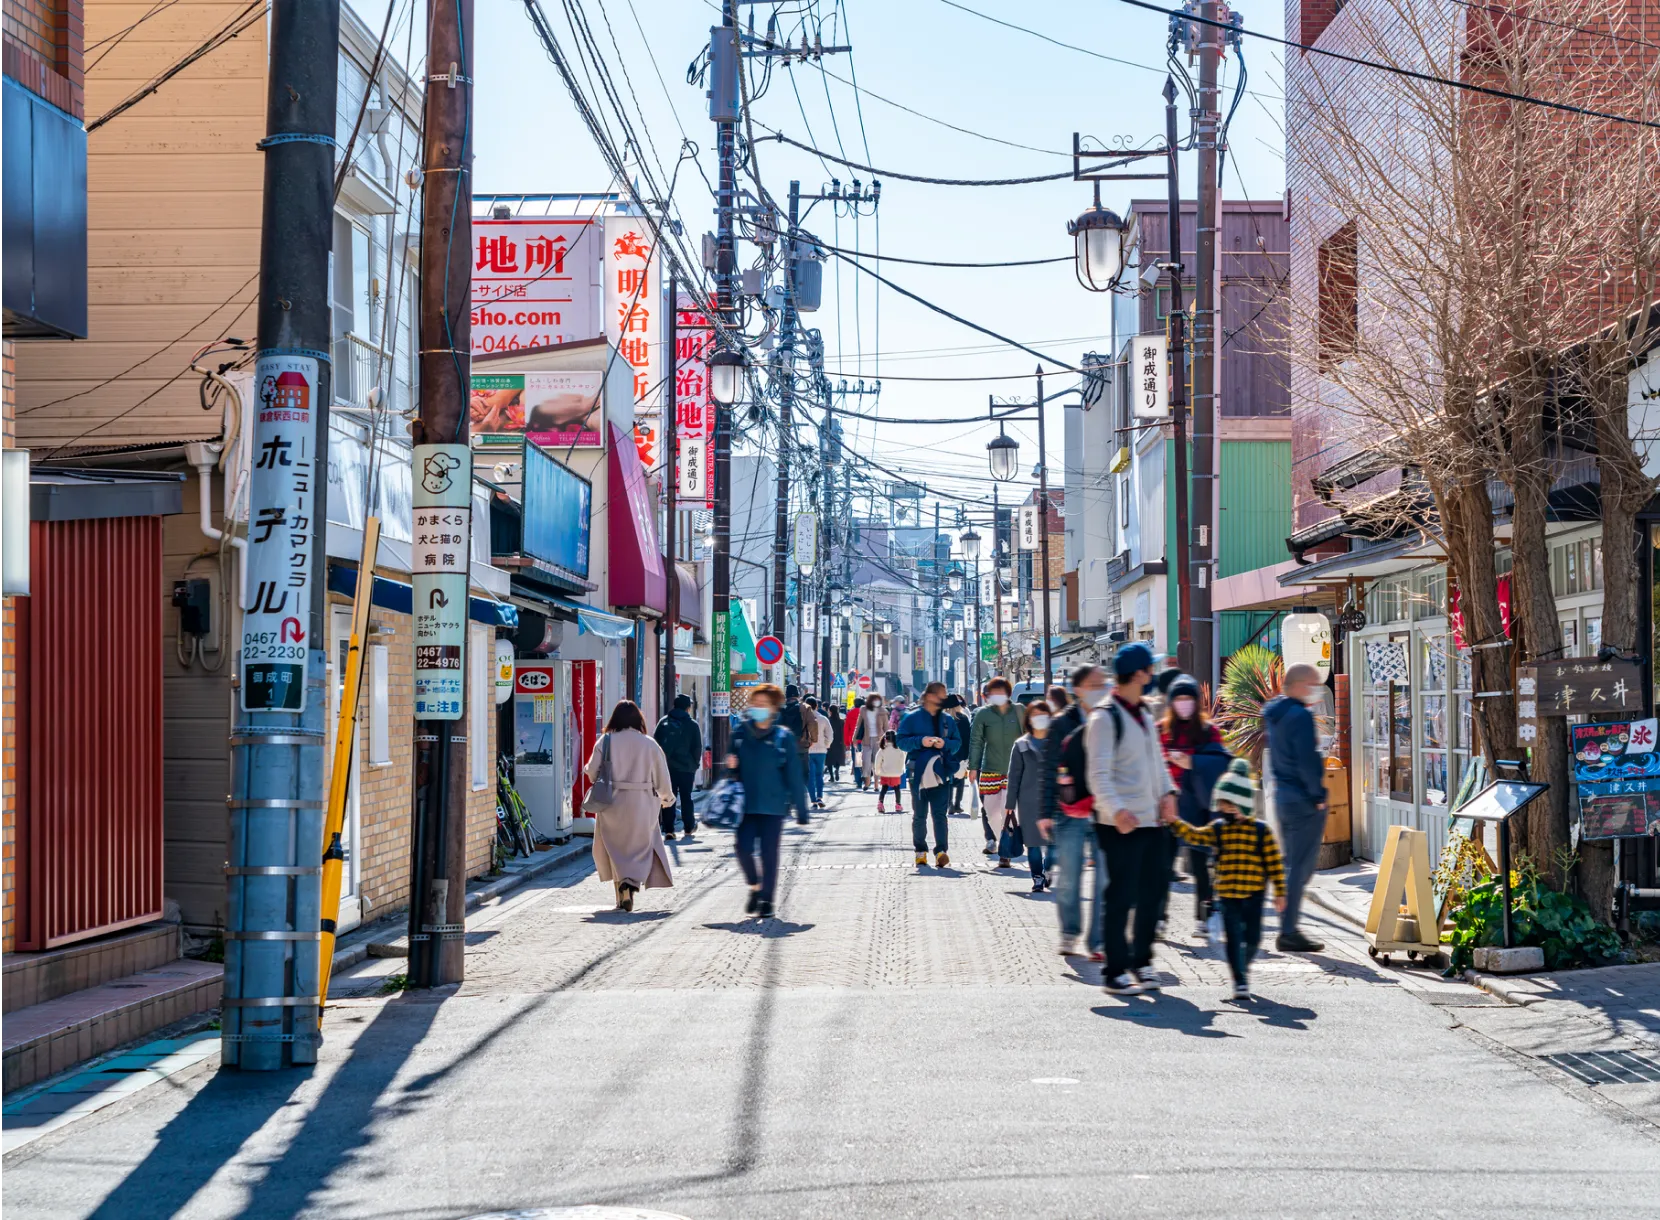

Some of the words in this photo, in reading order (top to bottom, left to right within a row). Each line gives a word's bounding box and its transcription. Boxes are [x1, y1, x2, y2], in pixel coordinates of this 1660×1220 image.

[260, 362, 281, 372] EASY
[287, 363, 312, 372] STAY
[1143, 346, 1158, 409] 御成通り
[687, 445, 699, 491] 御成通り
[246, 434, 292, 615] ホテル
[417, 514, 463, 526] かまくら
[1024, 510, 1033, 544] 御成通り
[418, 533, 462, 545] 犬と猫の
[424, 553, 455, 566] 病院
[244, 632, 278, 645] 0467
[417, 630, 437, 638] 向かい
[243, 646, 306, 660] 22-2230
[417, 647, 442, 657] 0467
[417, 657, 460, 668] 22-4976
[253, 671, 294, 684] 御成町
[520, 674, 548, 686] たばこ
[267, 688, 273, 700] 1
[1554, 678, 1629, 711] 津久井
[415, 700, 460, 713] 車に注意
[1630, 725, 1653, 745] 氷
